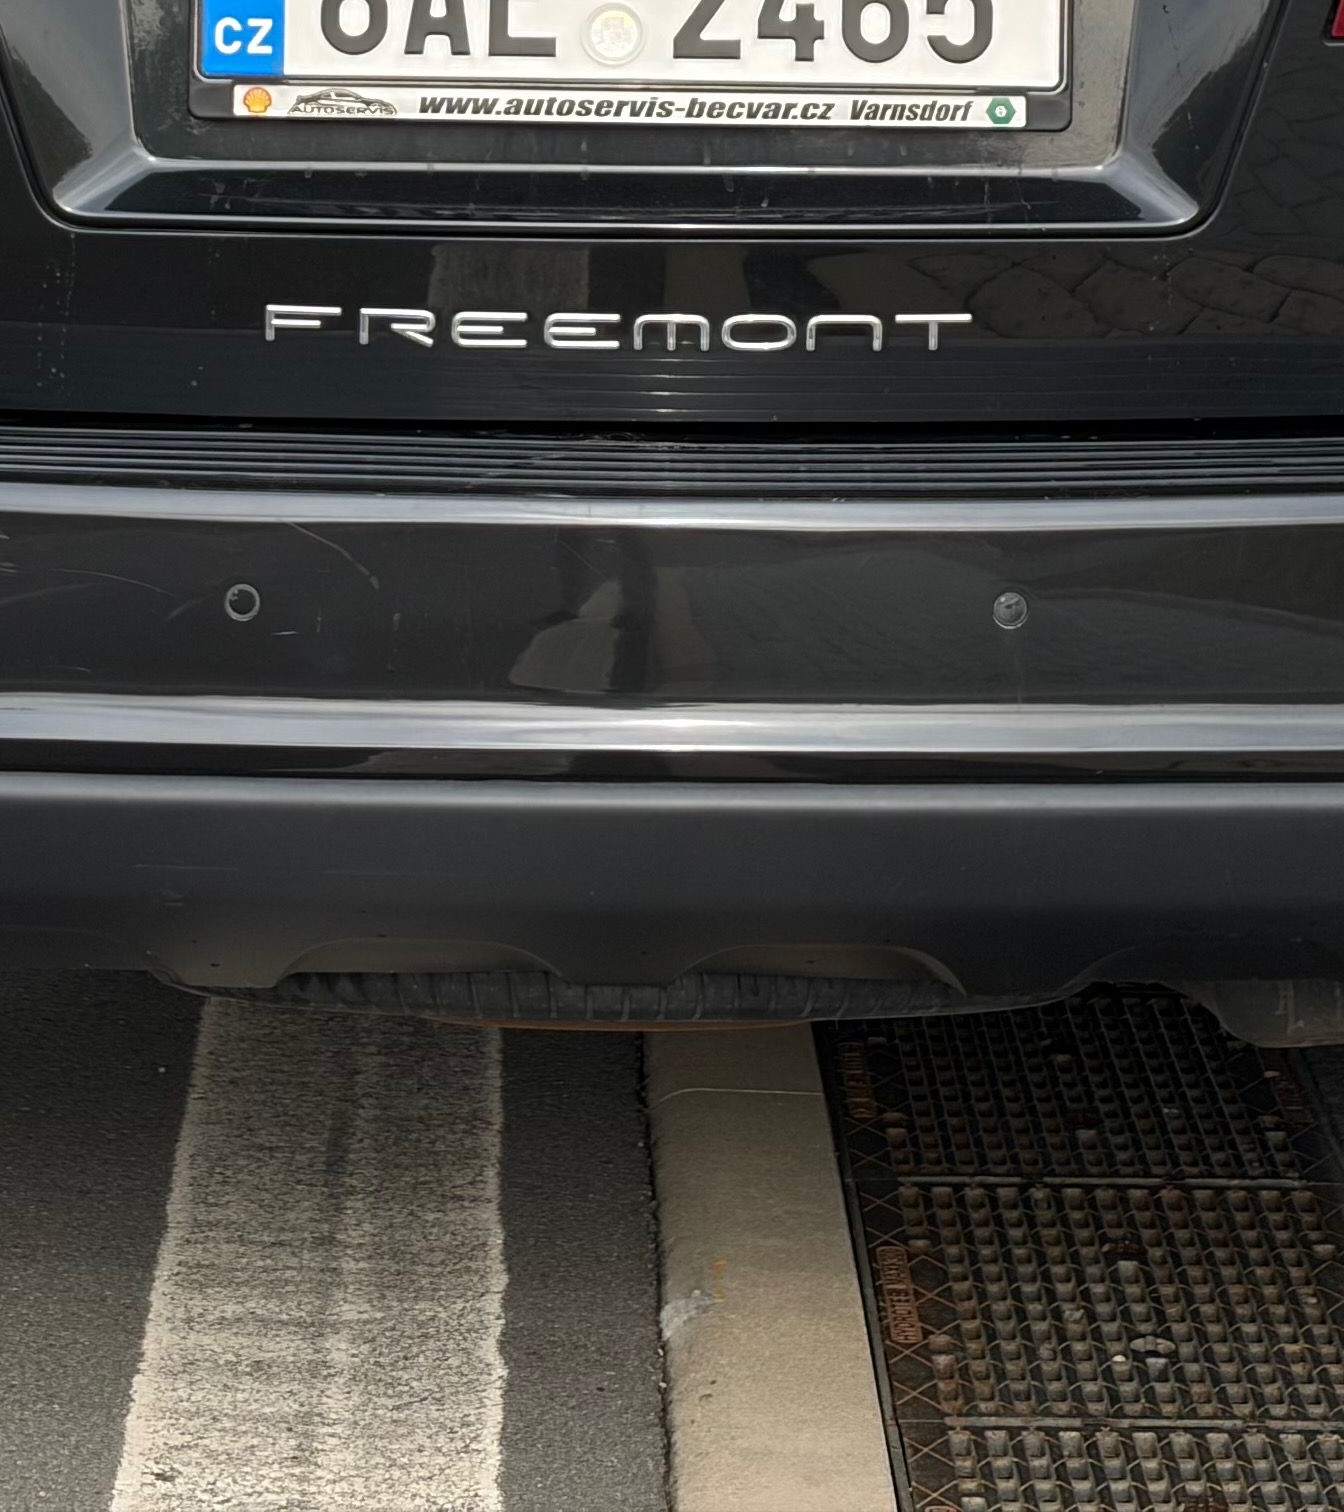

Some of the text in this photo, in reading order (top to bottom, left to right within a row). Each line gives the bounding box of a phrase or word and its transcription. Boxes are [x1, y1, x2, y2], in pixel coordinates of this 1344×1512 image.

[214, 17, 273, 55] CZ
[291, 106, 394, 115] AUTOSERVIS
[419, 95, 974, 122] www.autoservis-becvar.cz Varnsdorf
[265, 304, 973, 352] FREEMONT
